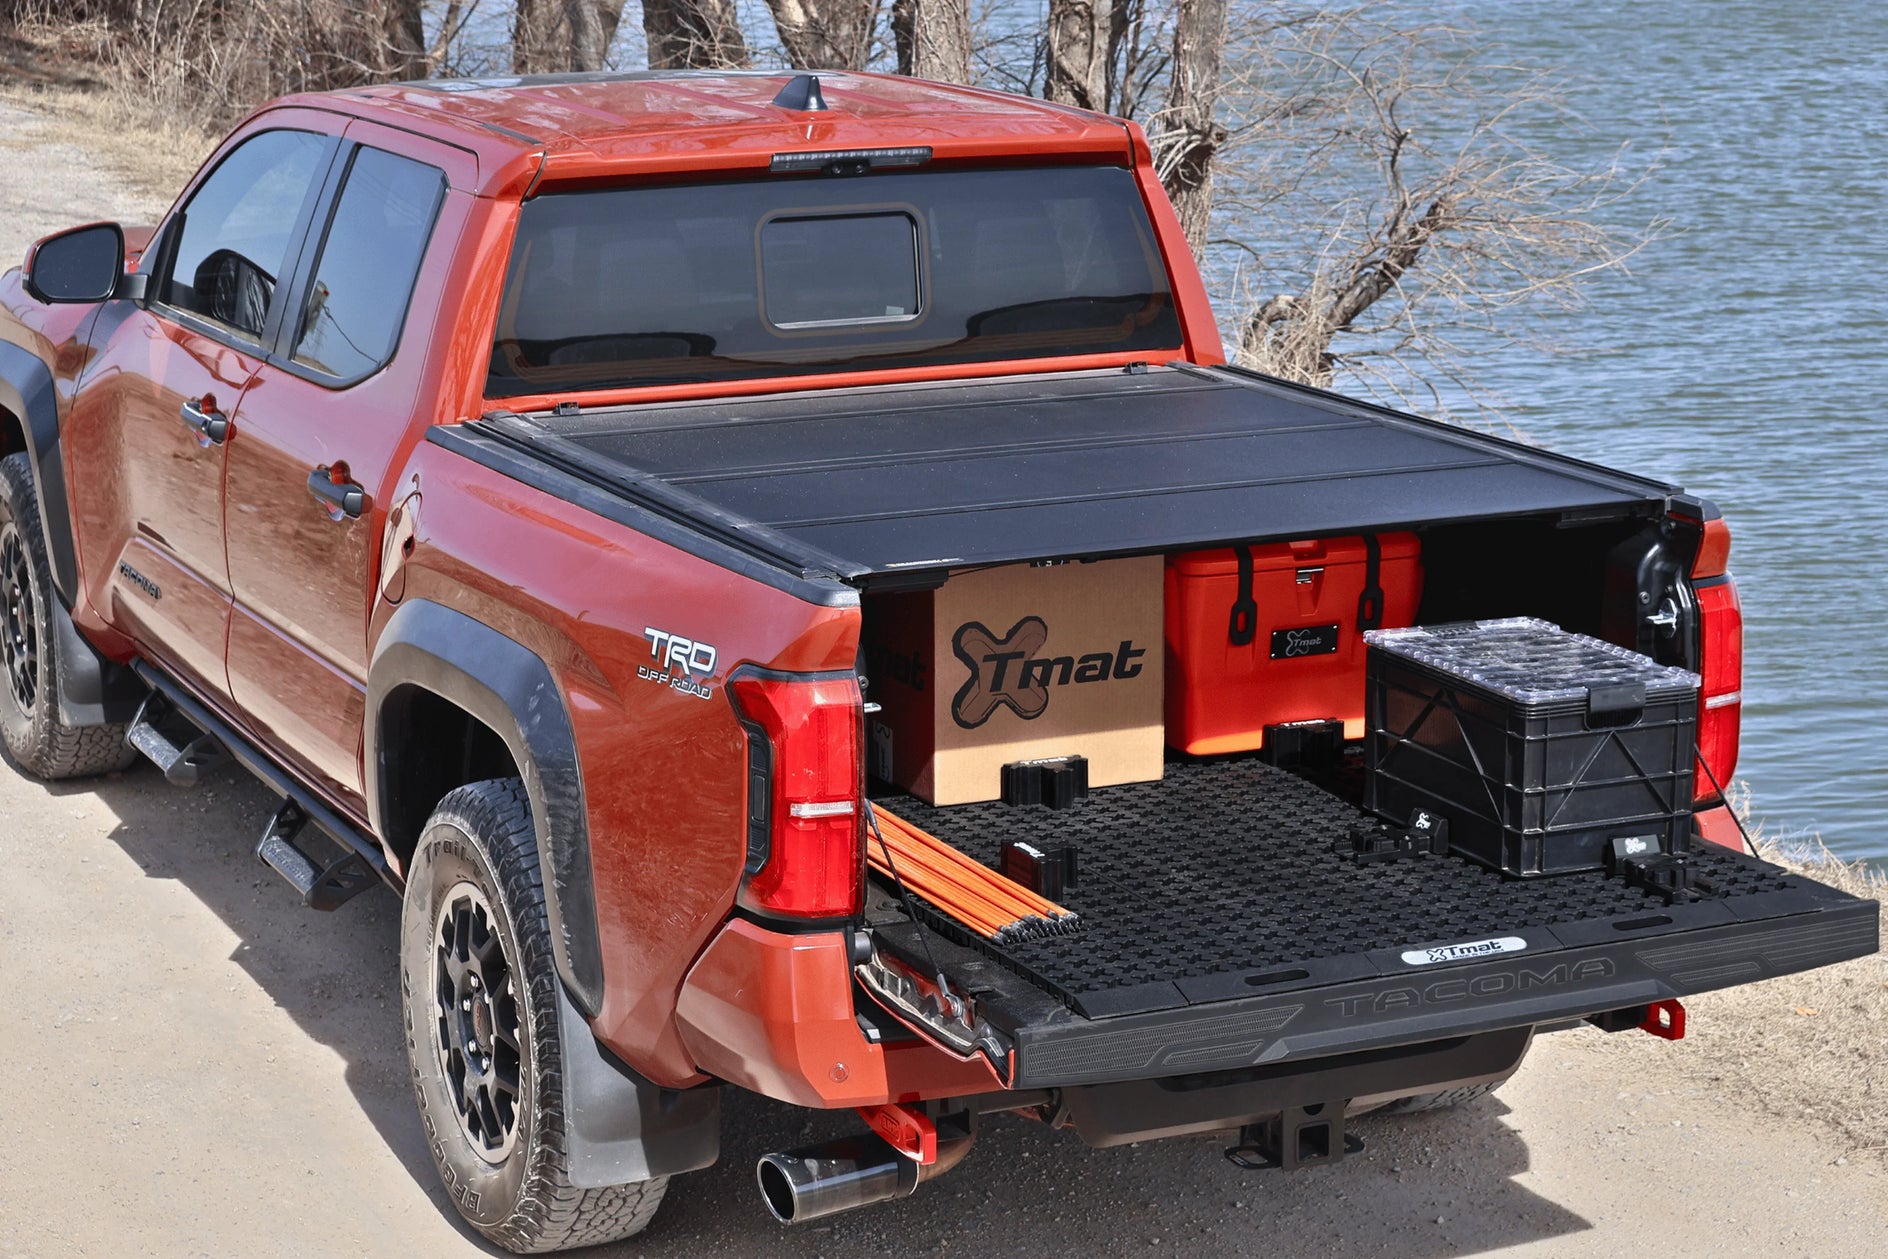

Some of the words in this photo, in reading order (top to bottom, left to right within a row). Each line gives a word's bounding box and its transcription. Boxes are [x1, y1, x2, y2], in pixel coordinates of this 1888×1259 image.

[644, 626, 717, 677] TRD
[637, 665, 669, 684] OFF
[669, 677, 713, 700] ROAD
[1323, 956, 1616, 1018] TACOMA
